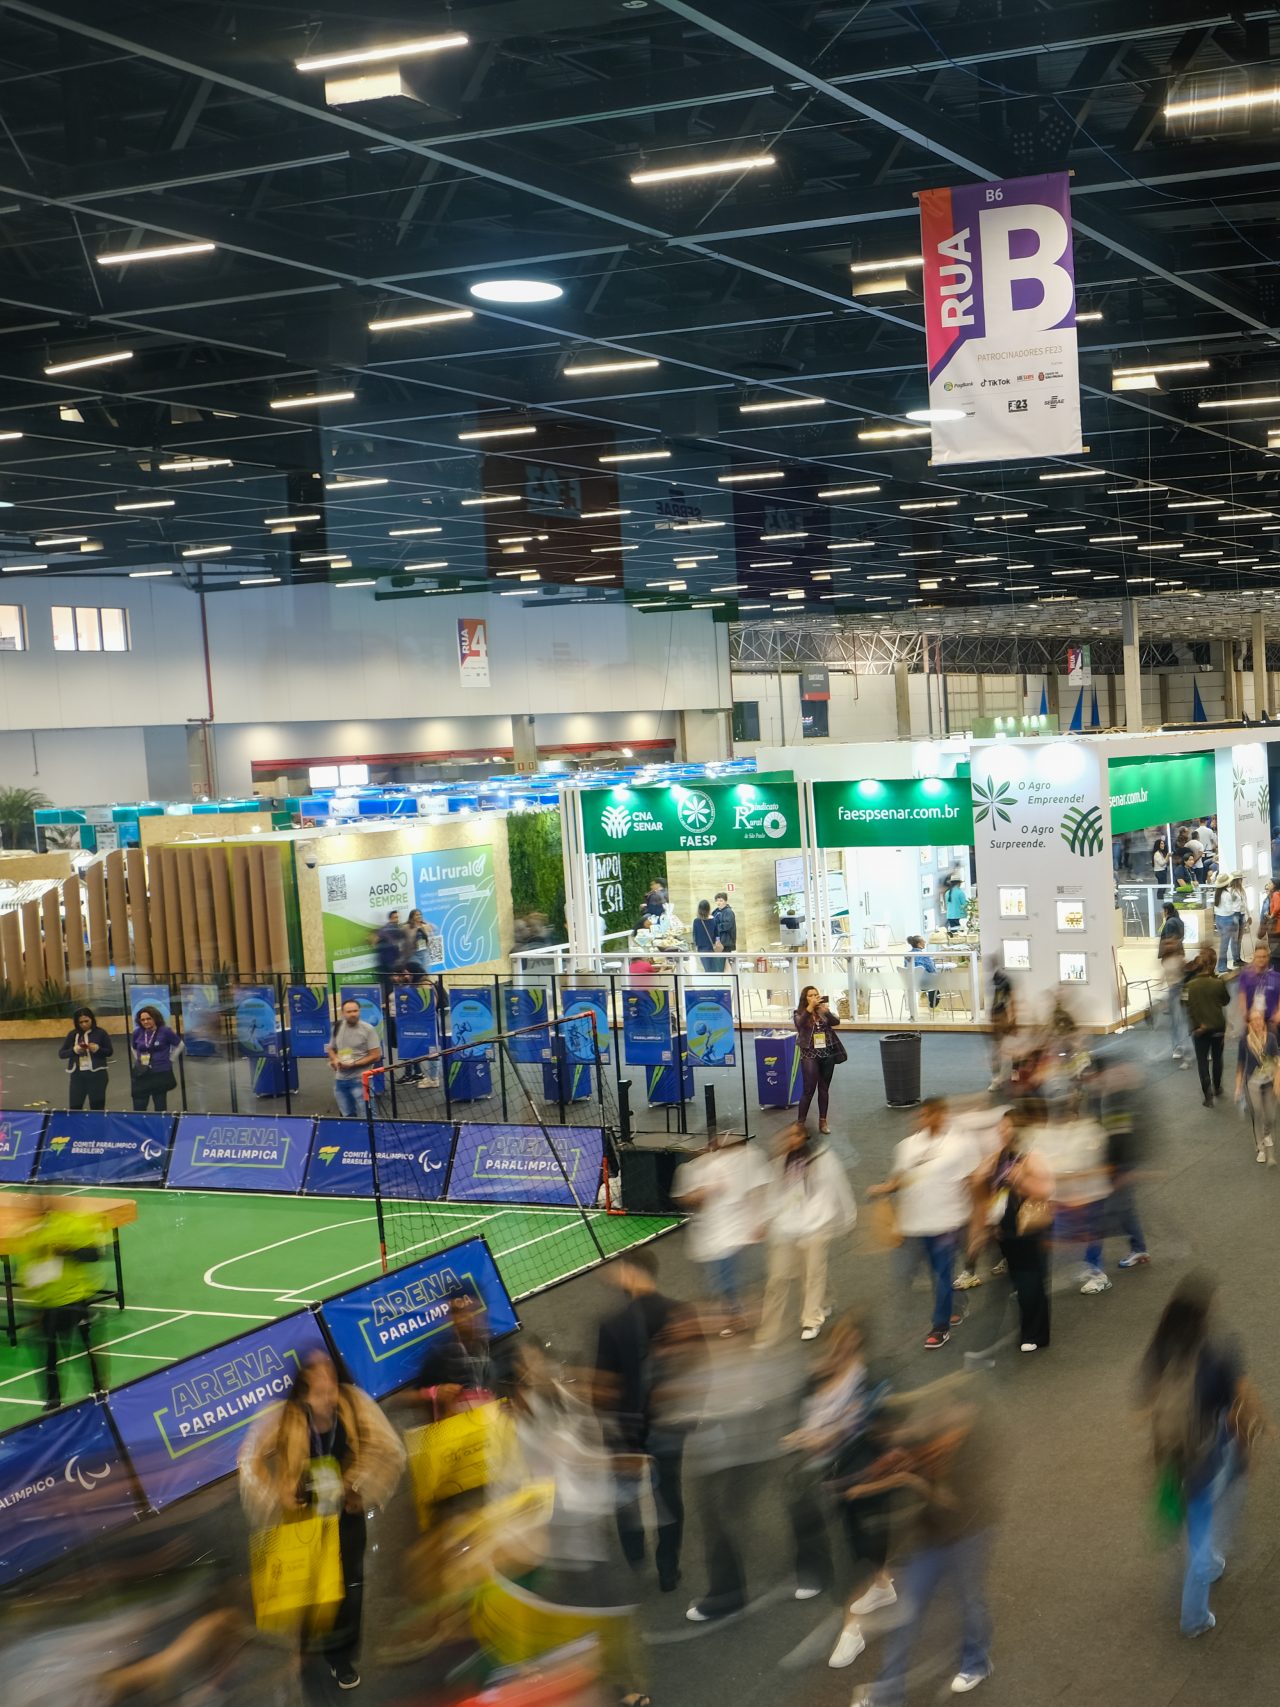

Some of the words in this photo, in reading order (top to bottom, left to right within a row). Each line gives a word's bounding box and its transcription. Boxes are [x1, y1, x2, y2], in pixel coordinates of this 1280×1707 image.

[986, 188, 1003, 201] B6
[937, 227, 975, 328] RUA
[979, 204, 1073, 336] B
[977, 347, 1043, 362] PATROCINADORES
[1045, 345, 1062, 355] FE23
[988, 378, 1010, 387] TikTok
[460, 628, 470, 654] RUA
[471, 624, 487, 657] 4
[1018, 781, 1026, 791] O
[1028, 781, 1051, 791] Agro
[1028, 794, 1085, 806] Empreende!
[632, 811, 653, 821] CNA
[838, 805, 960, 822] faespsenar.com.br
[633, 822, 663, 831] SENAR
[1021, 825, 1029, 834] O
[1031, 825, 1054, 836] Agro
[680, 835, 717, 847] FAESP
[990, 839, 1046, 851] Surpreende.
[369, 882, 398, 897] AGRO
[370, 892, 409, 908] SEMPRE
[206, 1126, 278, 1147] ARENA
[71, 1147, 105, 1155] BRASILEIRO
[371, 1267, 463, 1327] ARENA
[171, 1345, 284, 1417] ARENA
